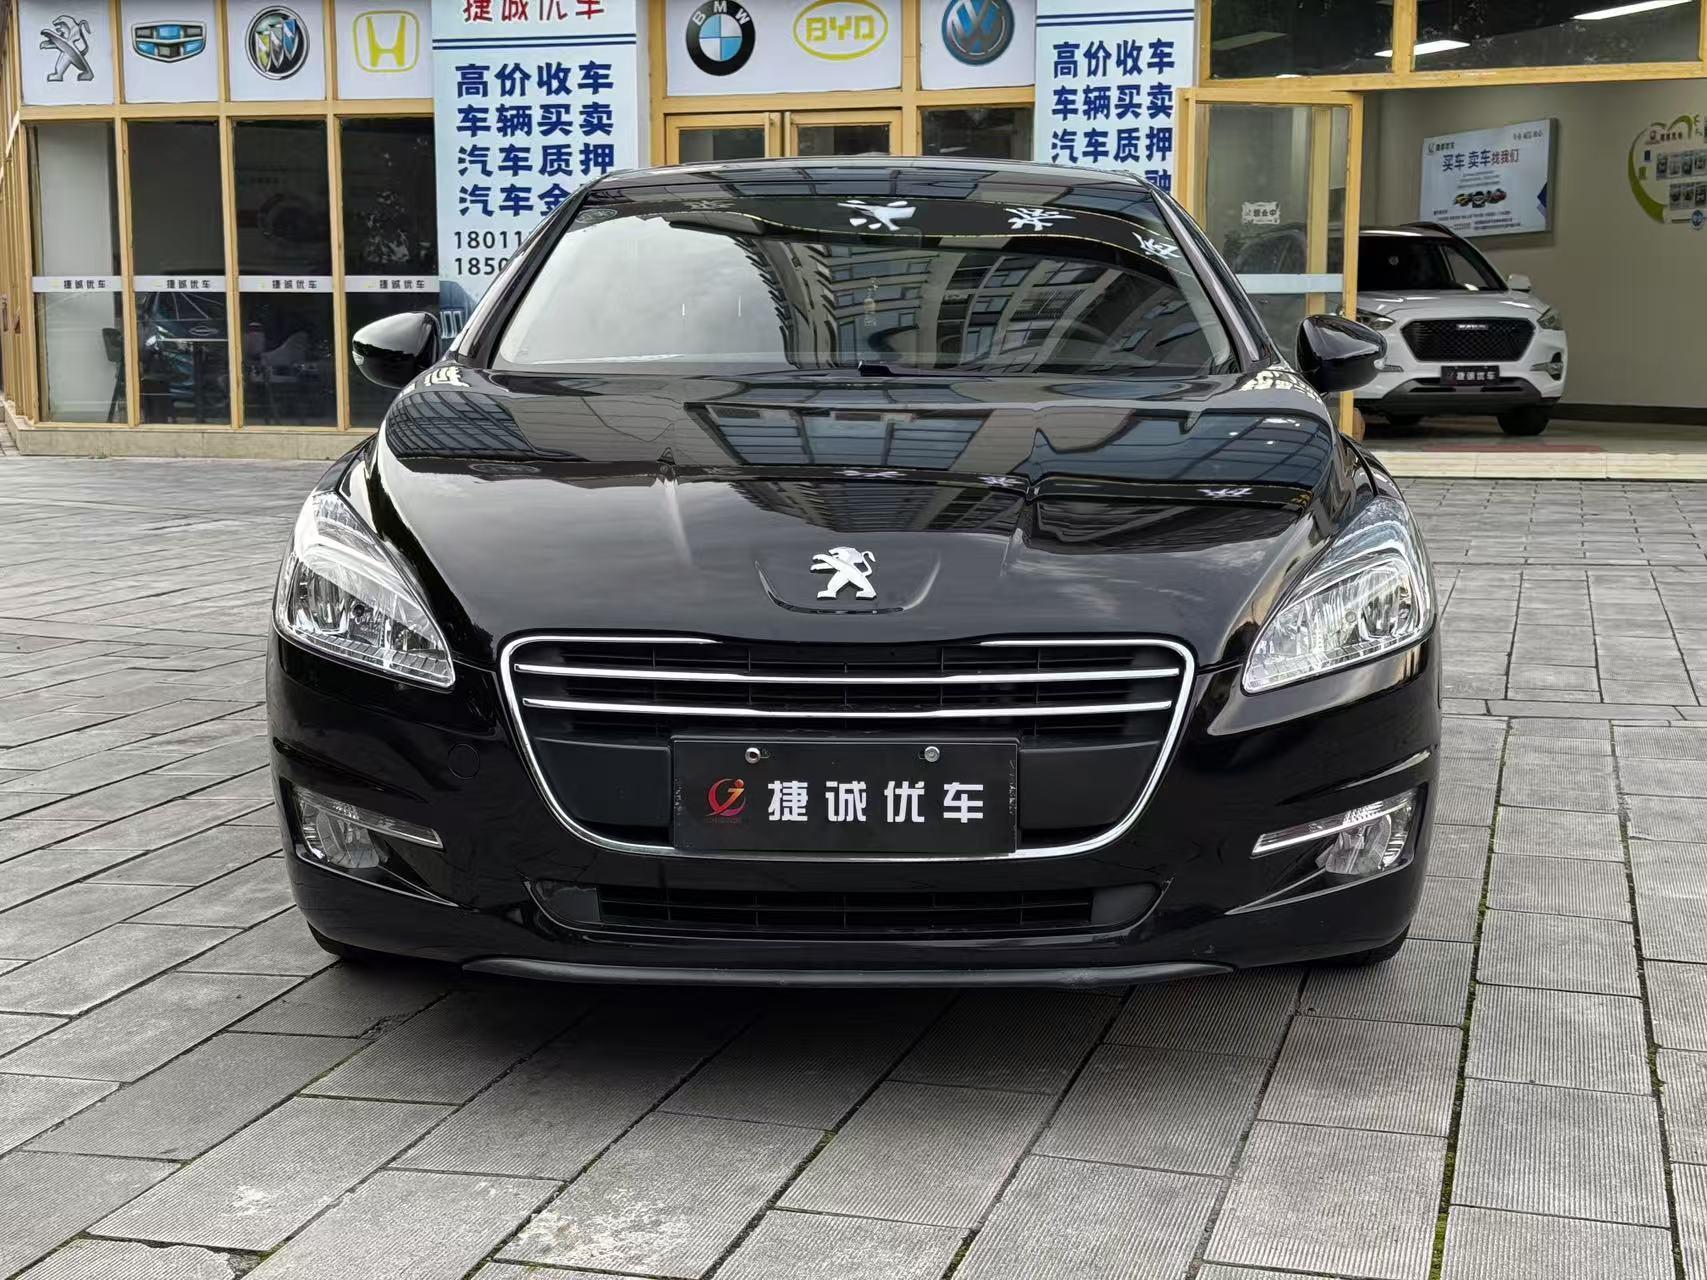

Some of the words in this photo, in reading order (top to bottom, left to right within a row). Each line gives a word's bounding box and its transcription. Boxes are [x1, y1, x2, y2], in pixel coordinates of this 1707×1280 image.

[692, 1, 751, 26] BMW
[806, 15, 874, 41] BYD
[1053, 38, 1175, 79] 高价收车
[455, 60, 614, 98] 高价收车
[1052, 82, 1173, 121] 车辆买卖
[456, 102, 614, 138] 车辆买卖
[457, 142, 615, 177] 汽车质押
[1051, 126, 1173, 164] 汽车质押
[1442, 153, 1466, 172] 买车
[458, 183, 586, 217] 汽车金
[454, 230, 522, 249] 18011
[767, 780, 984, 823] 捷诚优车
